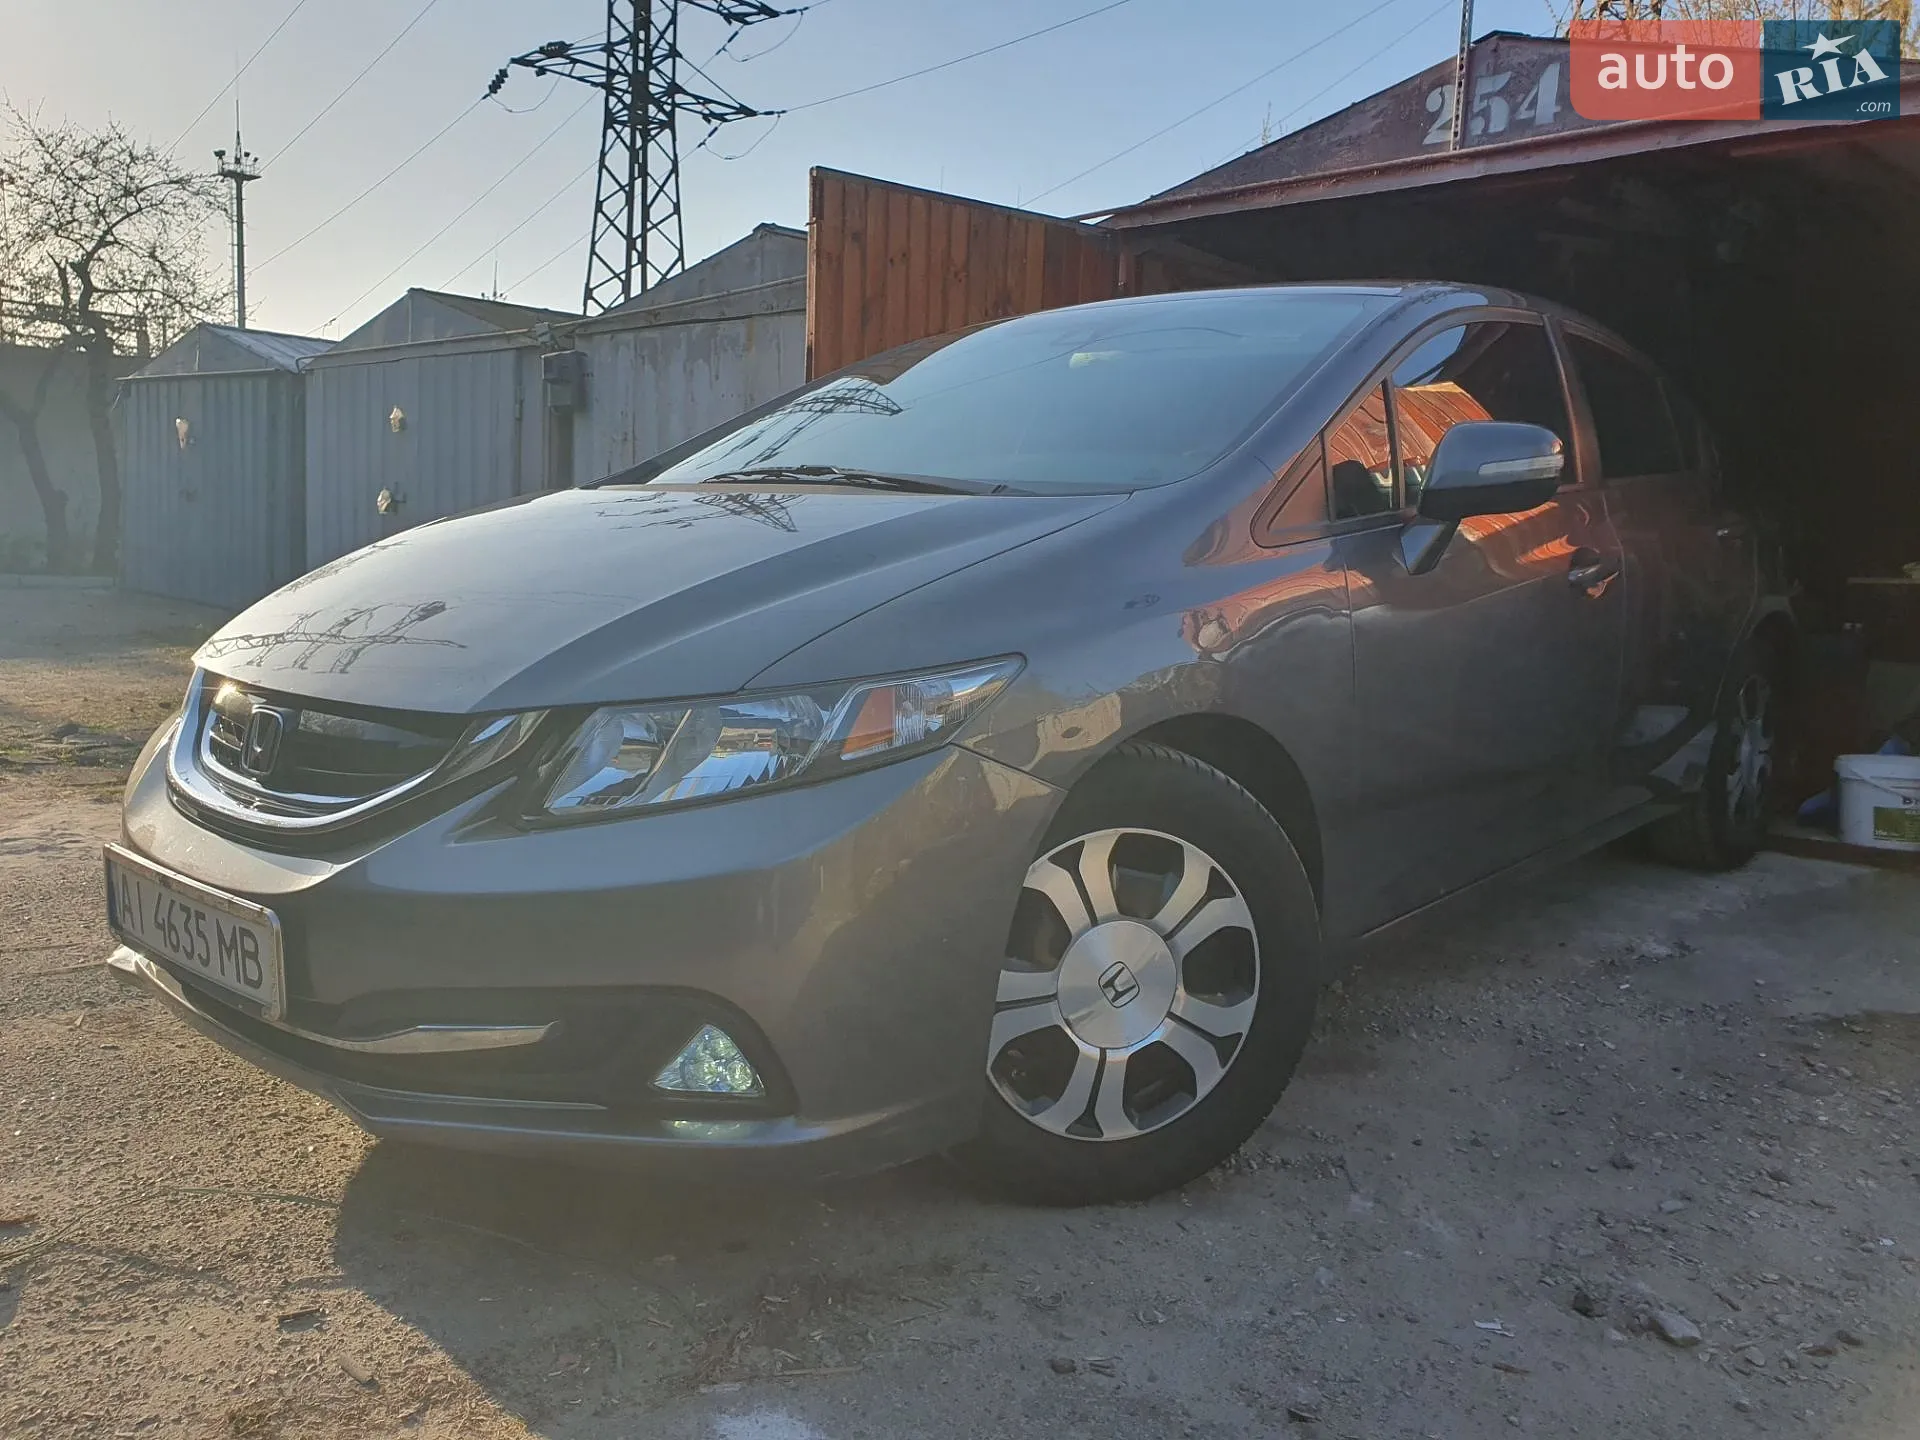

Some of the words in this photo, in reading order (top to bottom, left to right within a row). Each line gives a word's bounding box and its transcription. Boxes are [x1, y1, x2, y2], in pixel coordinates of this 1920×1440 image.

[1422, 62, 1561, 145] 254
[121, 872, 145, 935] AI
[153, 891, 211, 968] 4635
[215, 917, 264, 990] MB
